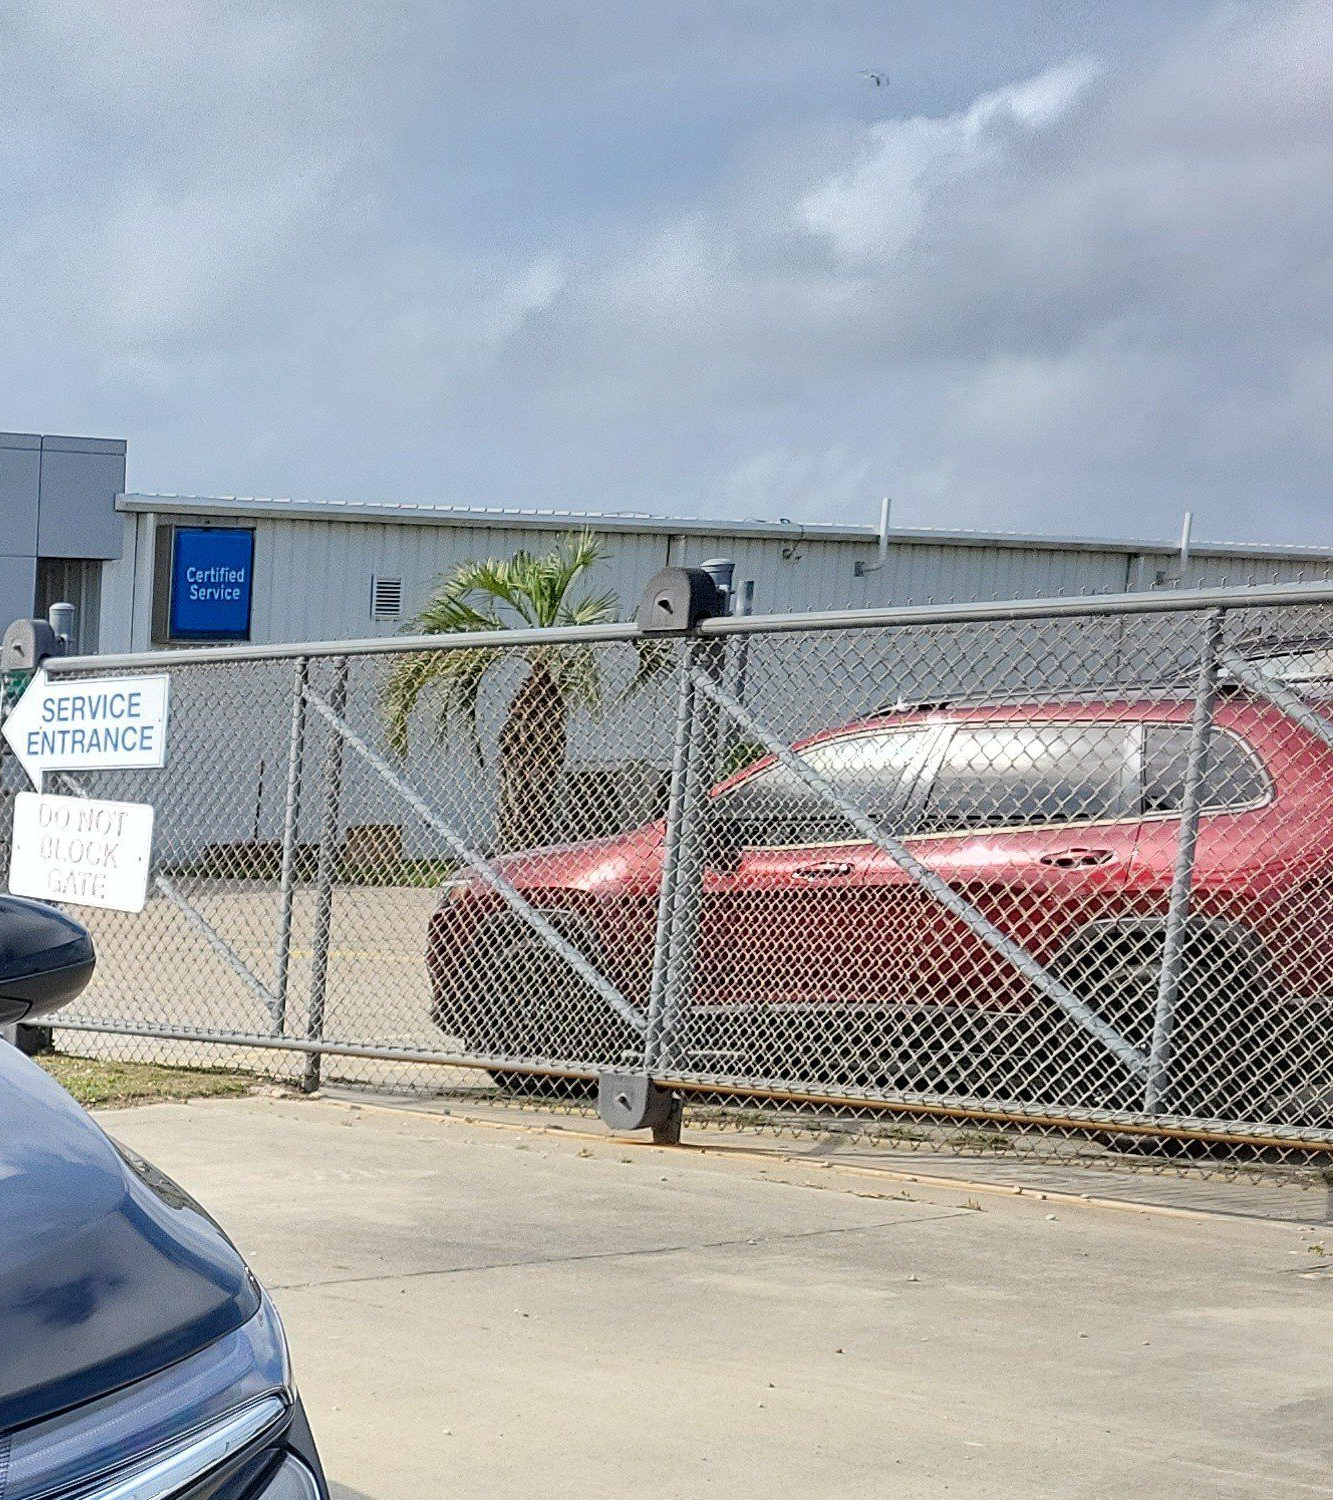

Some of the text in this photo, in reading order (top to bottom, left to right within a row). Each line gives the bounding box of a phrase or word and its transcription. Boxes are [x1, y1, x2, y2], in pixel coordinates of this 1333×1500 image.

[186, 566, 245, 583] Certified
[189, 583, 241, 600] Service
[41, 692, 142, 723] SERVICE
[26, 725, 154, 756] ENTRANCE
[39, 803, 129, 836] DO NOT
[40, 834, 119, 869] BLOCK
[48, 868, 107, 899] GATE
